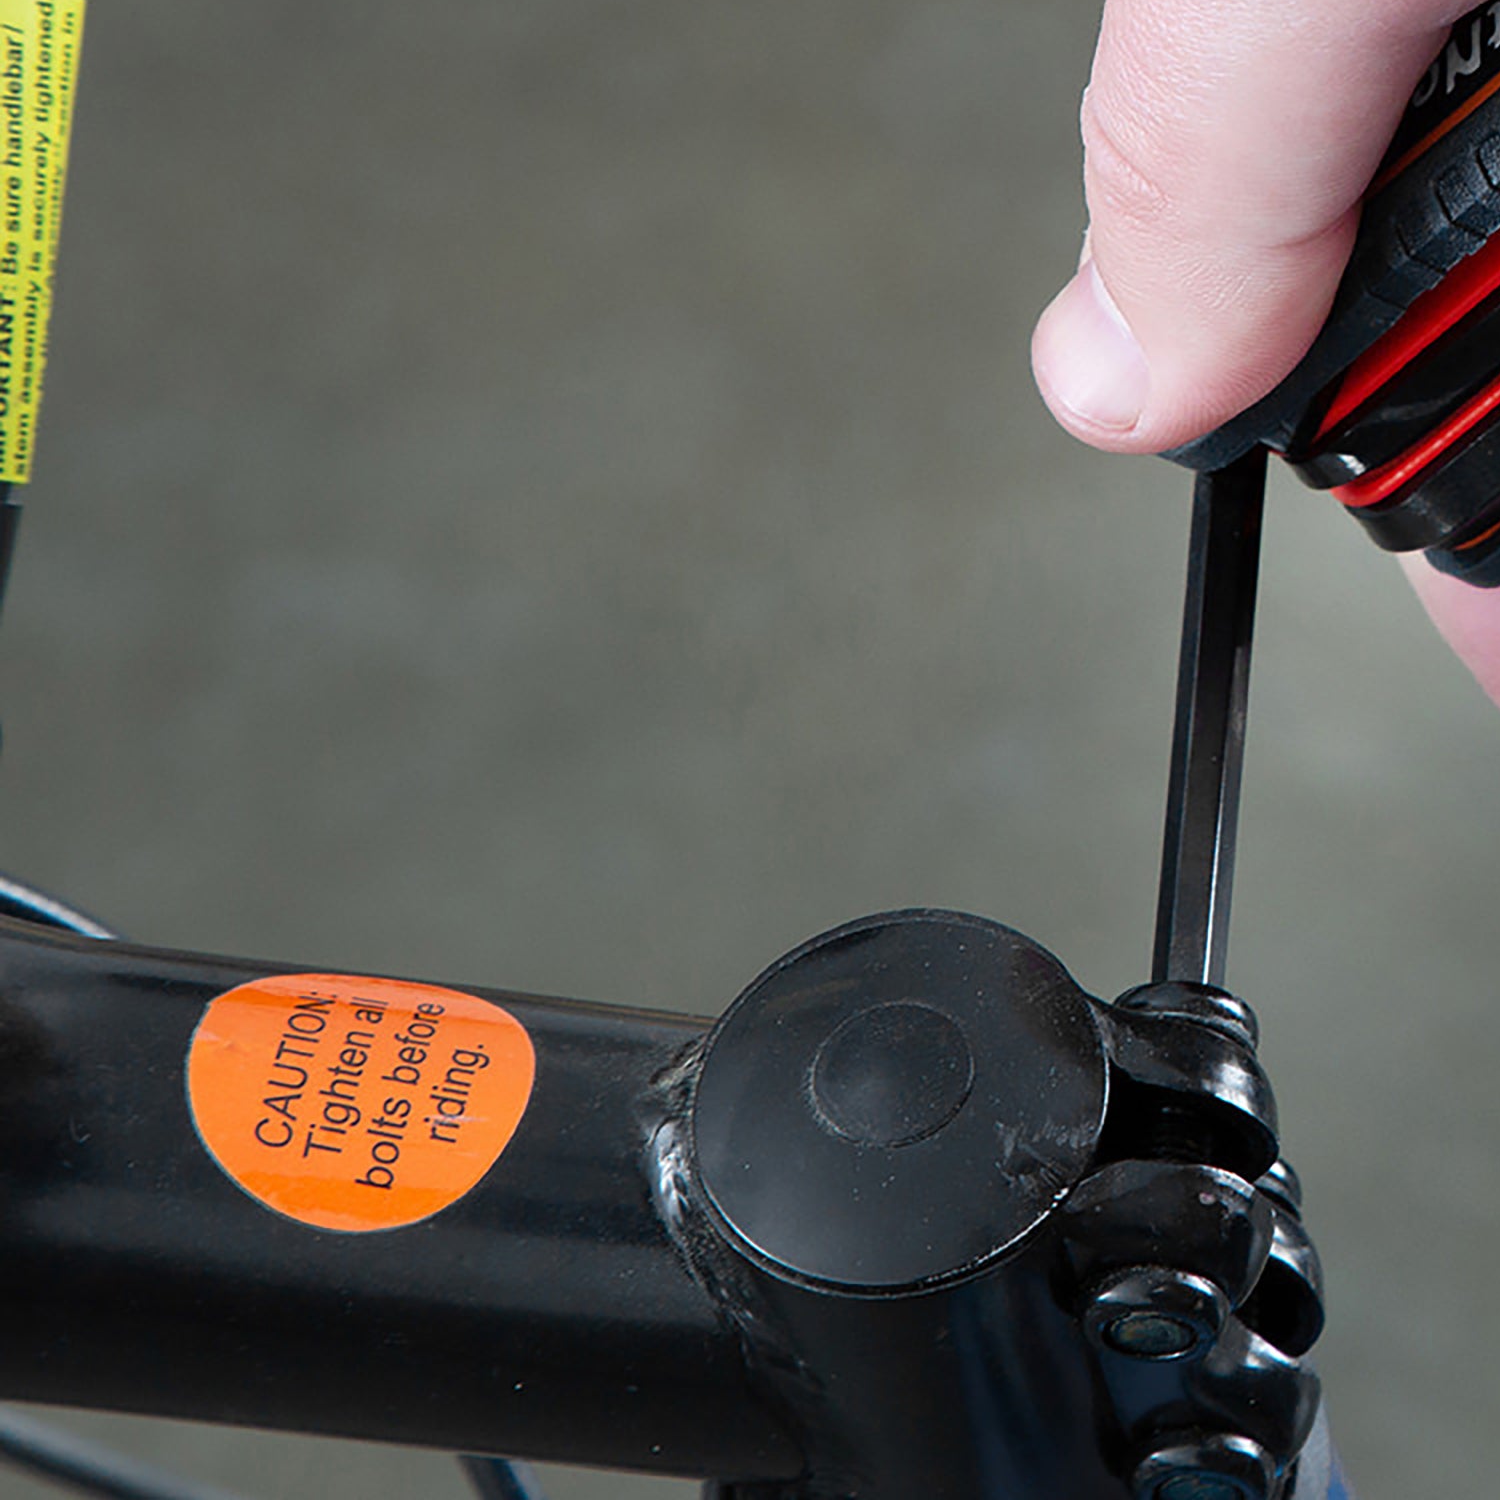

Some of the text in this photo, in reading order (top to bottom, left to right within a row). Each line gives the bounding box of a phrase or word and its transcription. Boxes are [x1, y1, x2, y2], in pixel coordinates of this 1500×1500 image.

[4, 176, 21, 232] sure
[20, 281, 41, 404] assembly
[31, 132, 51, 241] securely
[255, 991, 338, 1148] CAUTION:
[302, 996, 389, 1158] Tighten all
[354, 1002, 446, 1189] bolts before
[423, 1044, 491, 1143] riding.
